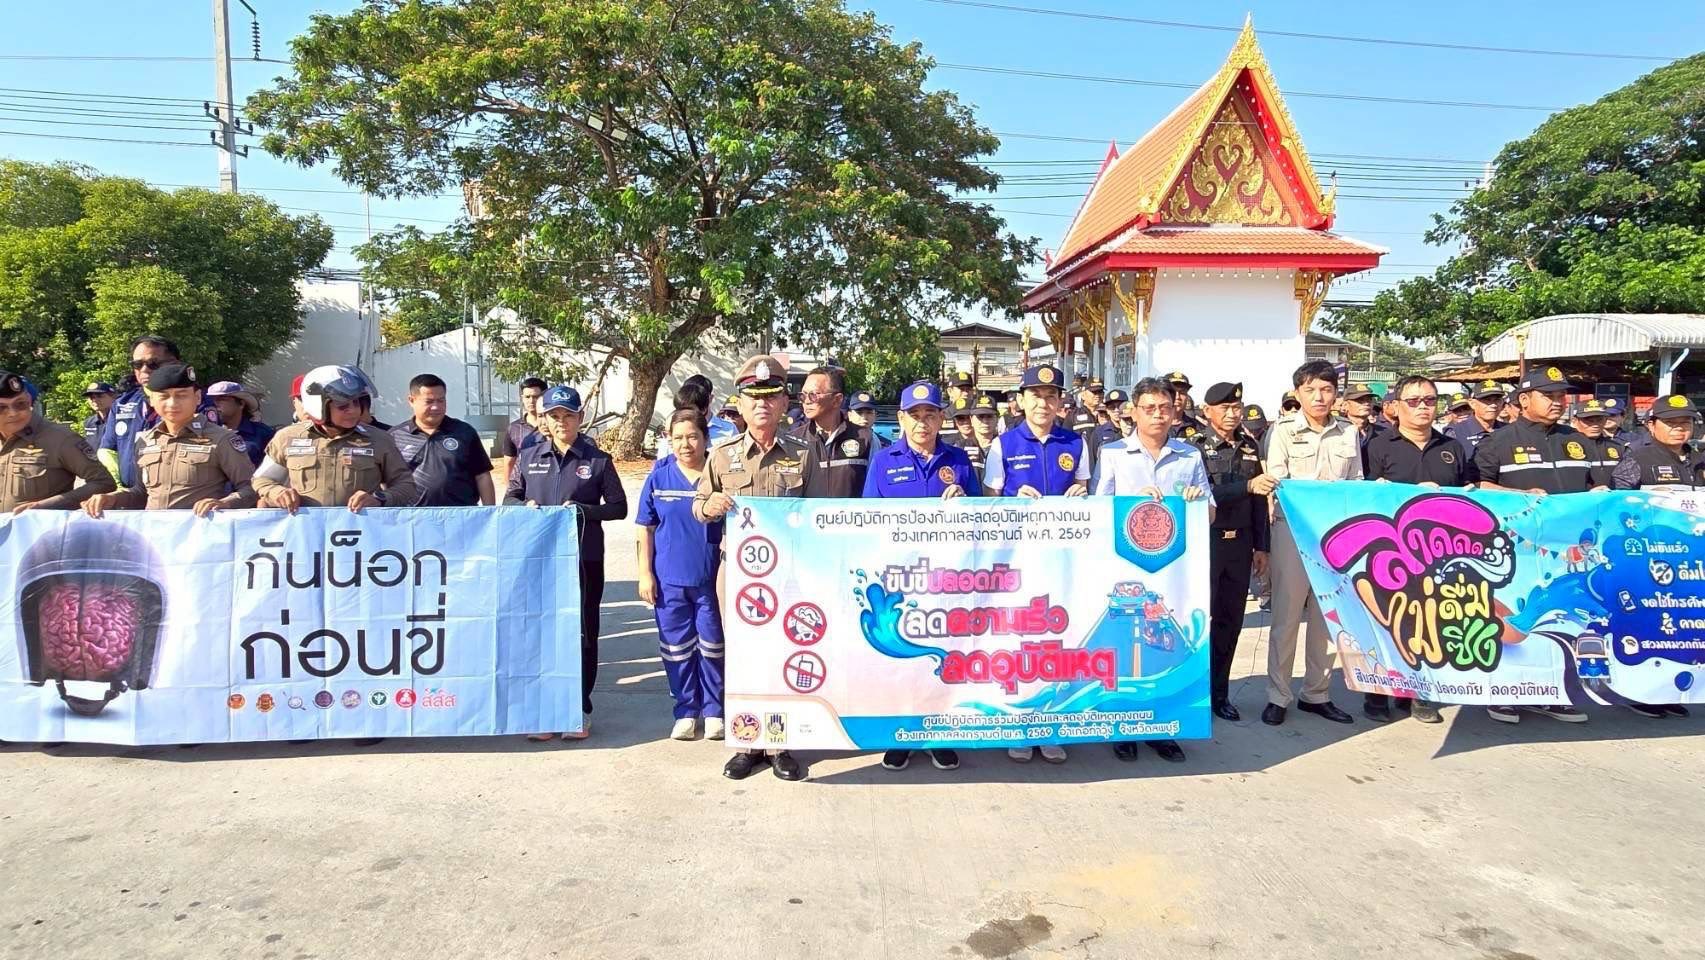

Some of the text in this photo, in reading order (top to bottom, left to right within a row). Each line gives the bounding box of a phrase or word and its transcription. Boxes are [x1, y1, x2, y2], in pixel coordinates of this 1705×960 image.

[815, 509, 1091, 530] ศูนย์ปฏิบัติการป้องกันและลดอุบัติเหตุทางถนน
[892, 526, 1091, 543] ช่วงเทศกาลสงกรานต์ พ.ศ. 2569
[245, 530, 447, 589] กันน็อก
[744, 545, 770, 563] 30
[884, 557, 1021, 595] ขับขี่ปลอดภัย
[904, 594, 1069, 638] ลดความเร็ว
[240, 592, 446, 680] ก่อนขี่
[940, 640, 1118, 695] ลดอุบัติเหตุ
[1436, 682, 1483, 696] ปลอดภัย
[1491, 682, 1559, 699] ลดอุบัติเหตุ
[896, 728, 1001, 741] ช่วงเทศกาลสงกรานต์
[1028, 727, 1052, 738] 2569
